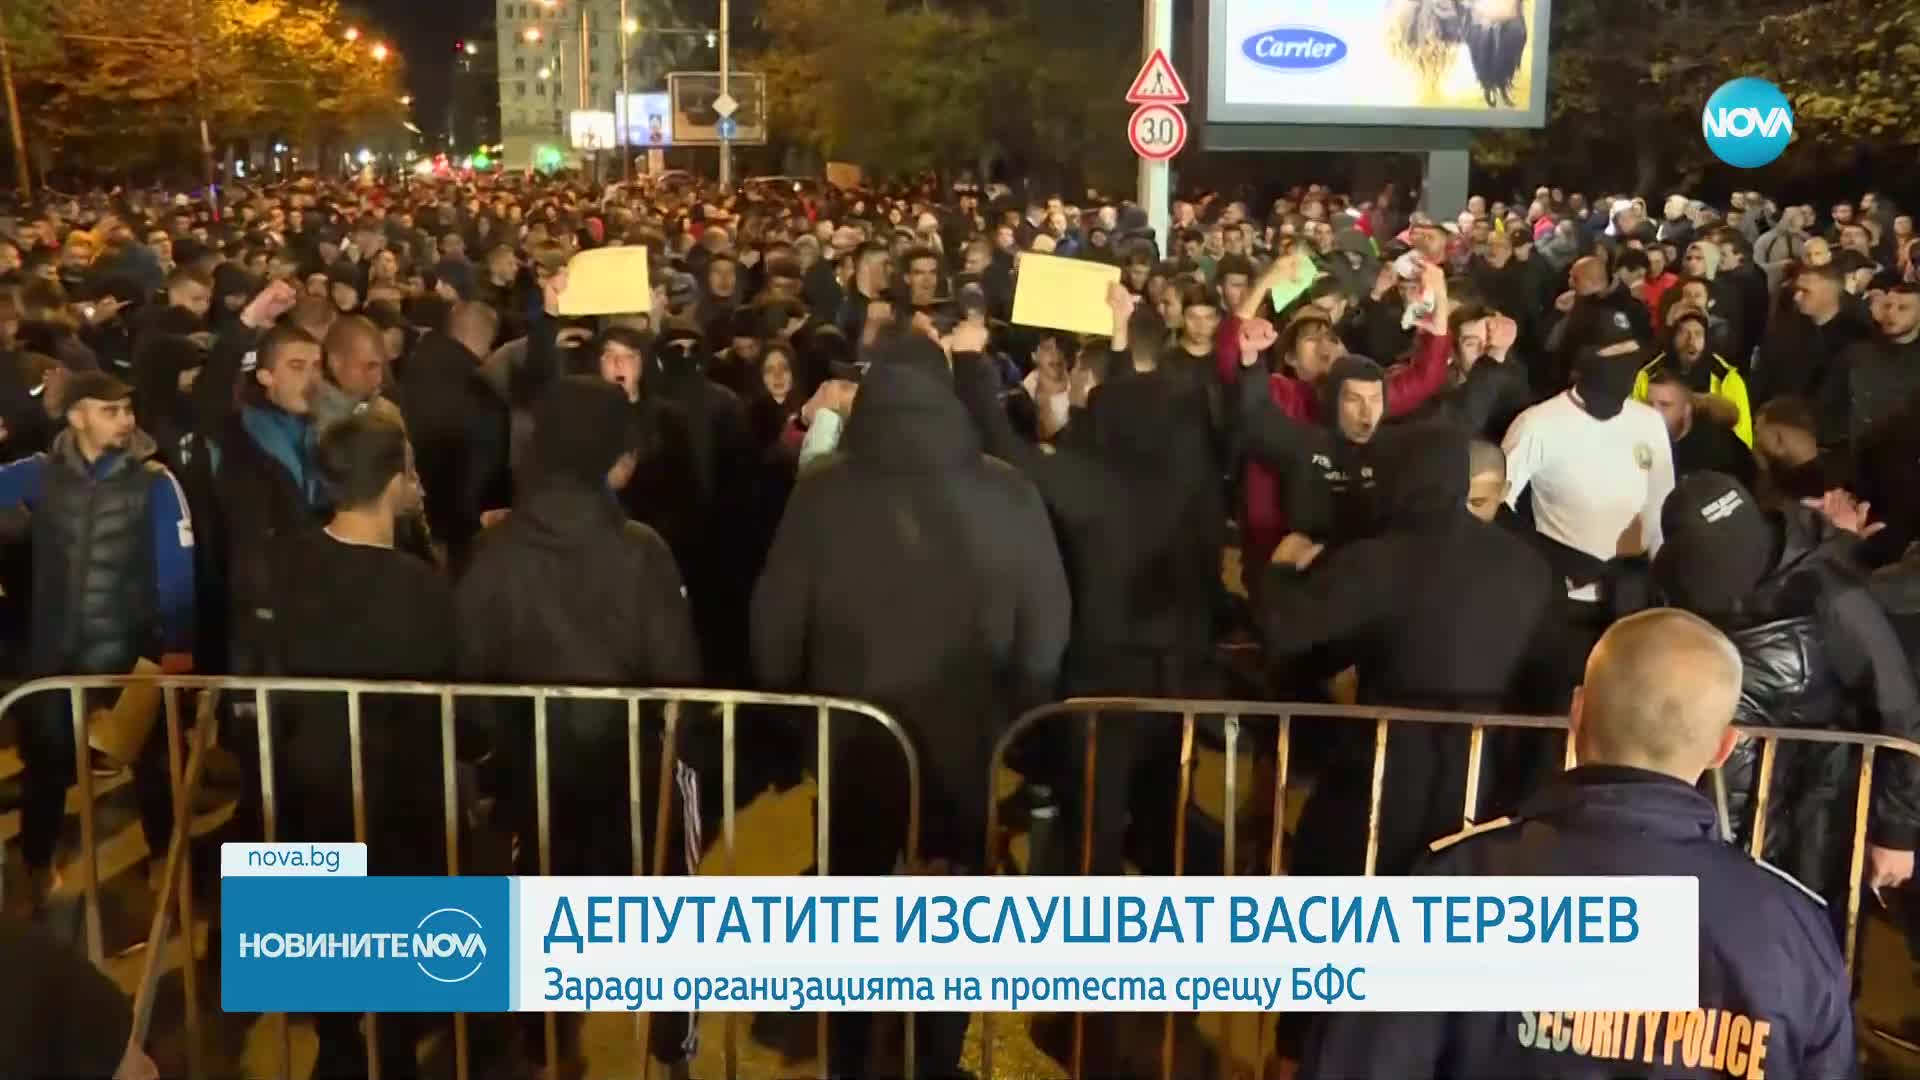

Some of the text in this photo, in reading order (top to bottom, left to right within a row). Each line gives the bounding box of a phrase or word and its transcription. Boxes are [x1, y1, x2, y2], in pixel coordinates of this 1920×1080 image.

[1255, 35, 1337, 59] Carrier
[1141, 117, 1174, 146] 30
[1518, 1009, 1771, 1080] SECURITY POLICE
